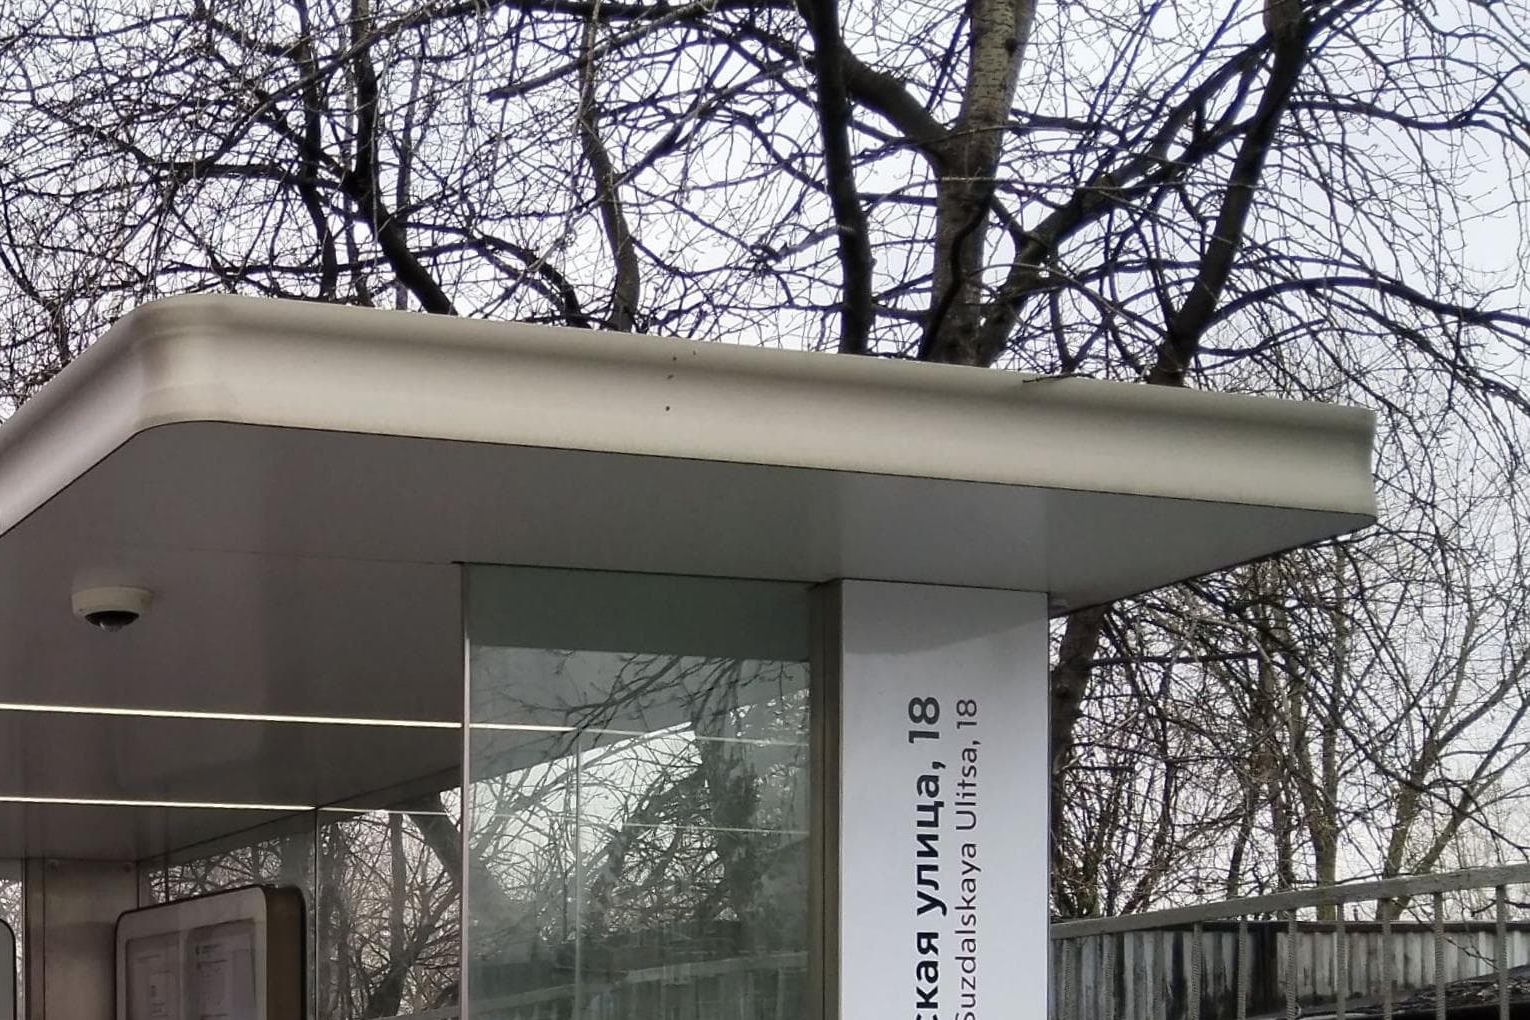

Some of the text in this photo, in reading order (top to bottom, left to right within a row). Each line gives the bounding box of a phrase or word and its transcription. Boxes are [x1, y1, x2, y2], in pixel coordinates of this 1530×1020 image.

[908, 697, 941, 745] 18
[956, 698, 978, 729] 18
[955, 738, 983, 831] Ulitsa,
[916, 759, 947, 917] улица,
